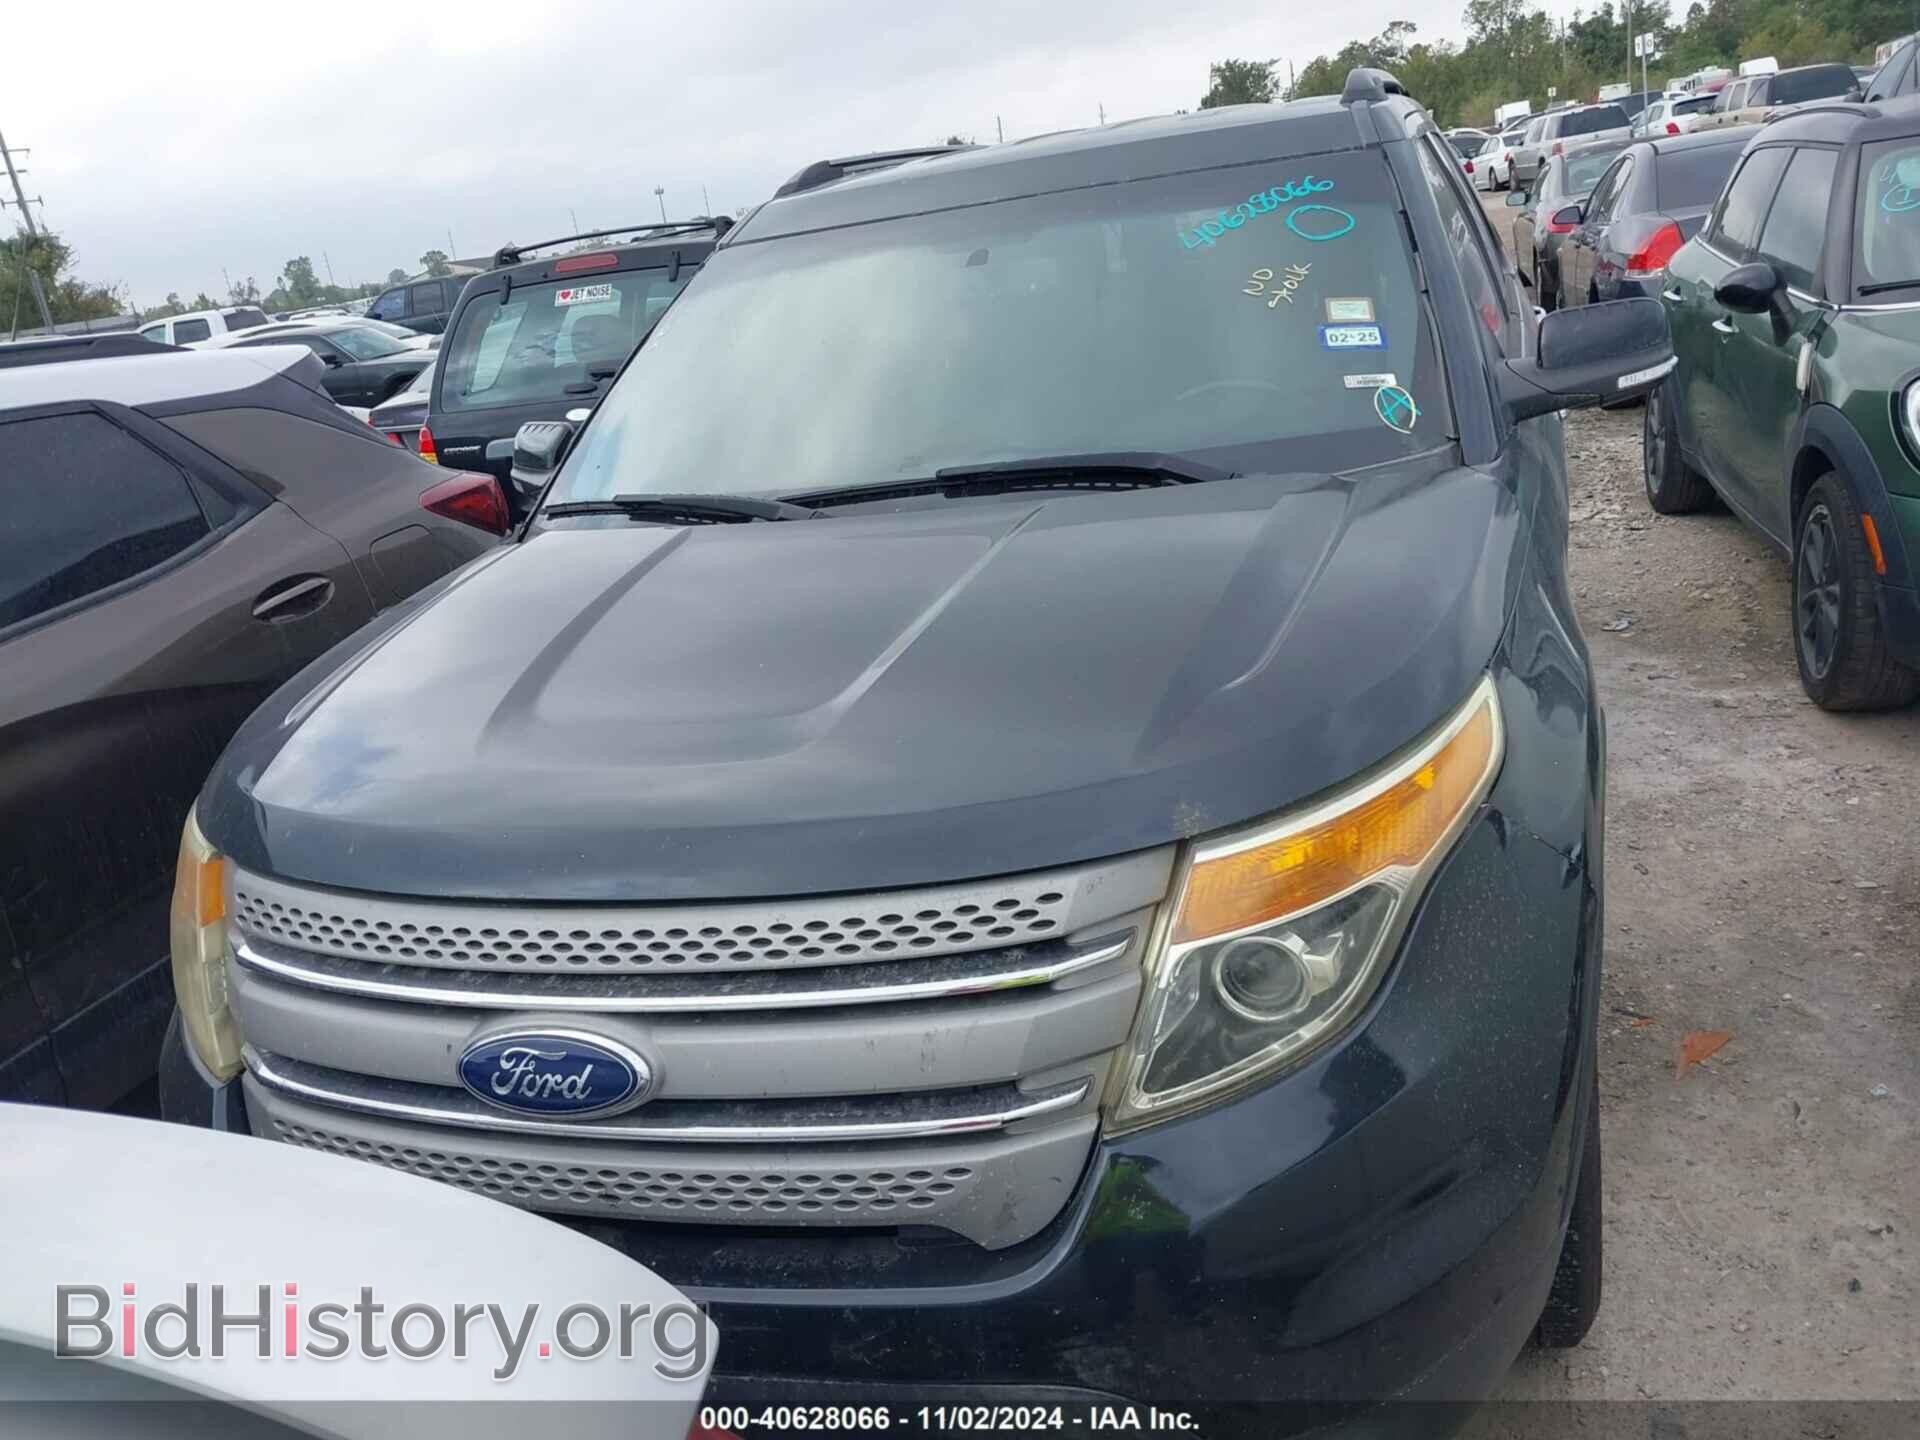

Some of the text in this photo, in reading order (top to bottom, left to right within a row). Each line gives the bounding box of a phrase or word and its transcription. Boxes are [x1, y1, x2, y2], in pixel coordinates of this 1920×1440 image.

[570, 288, 585, 299] JET
[586, 286, 609, 297] NOISE
[490, 1046, 594, 1100] Ford
